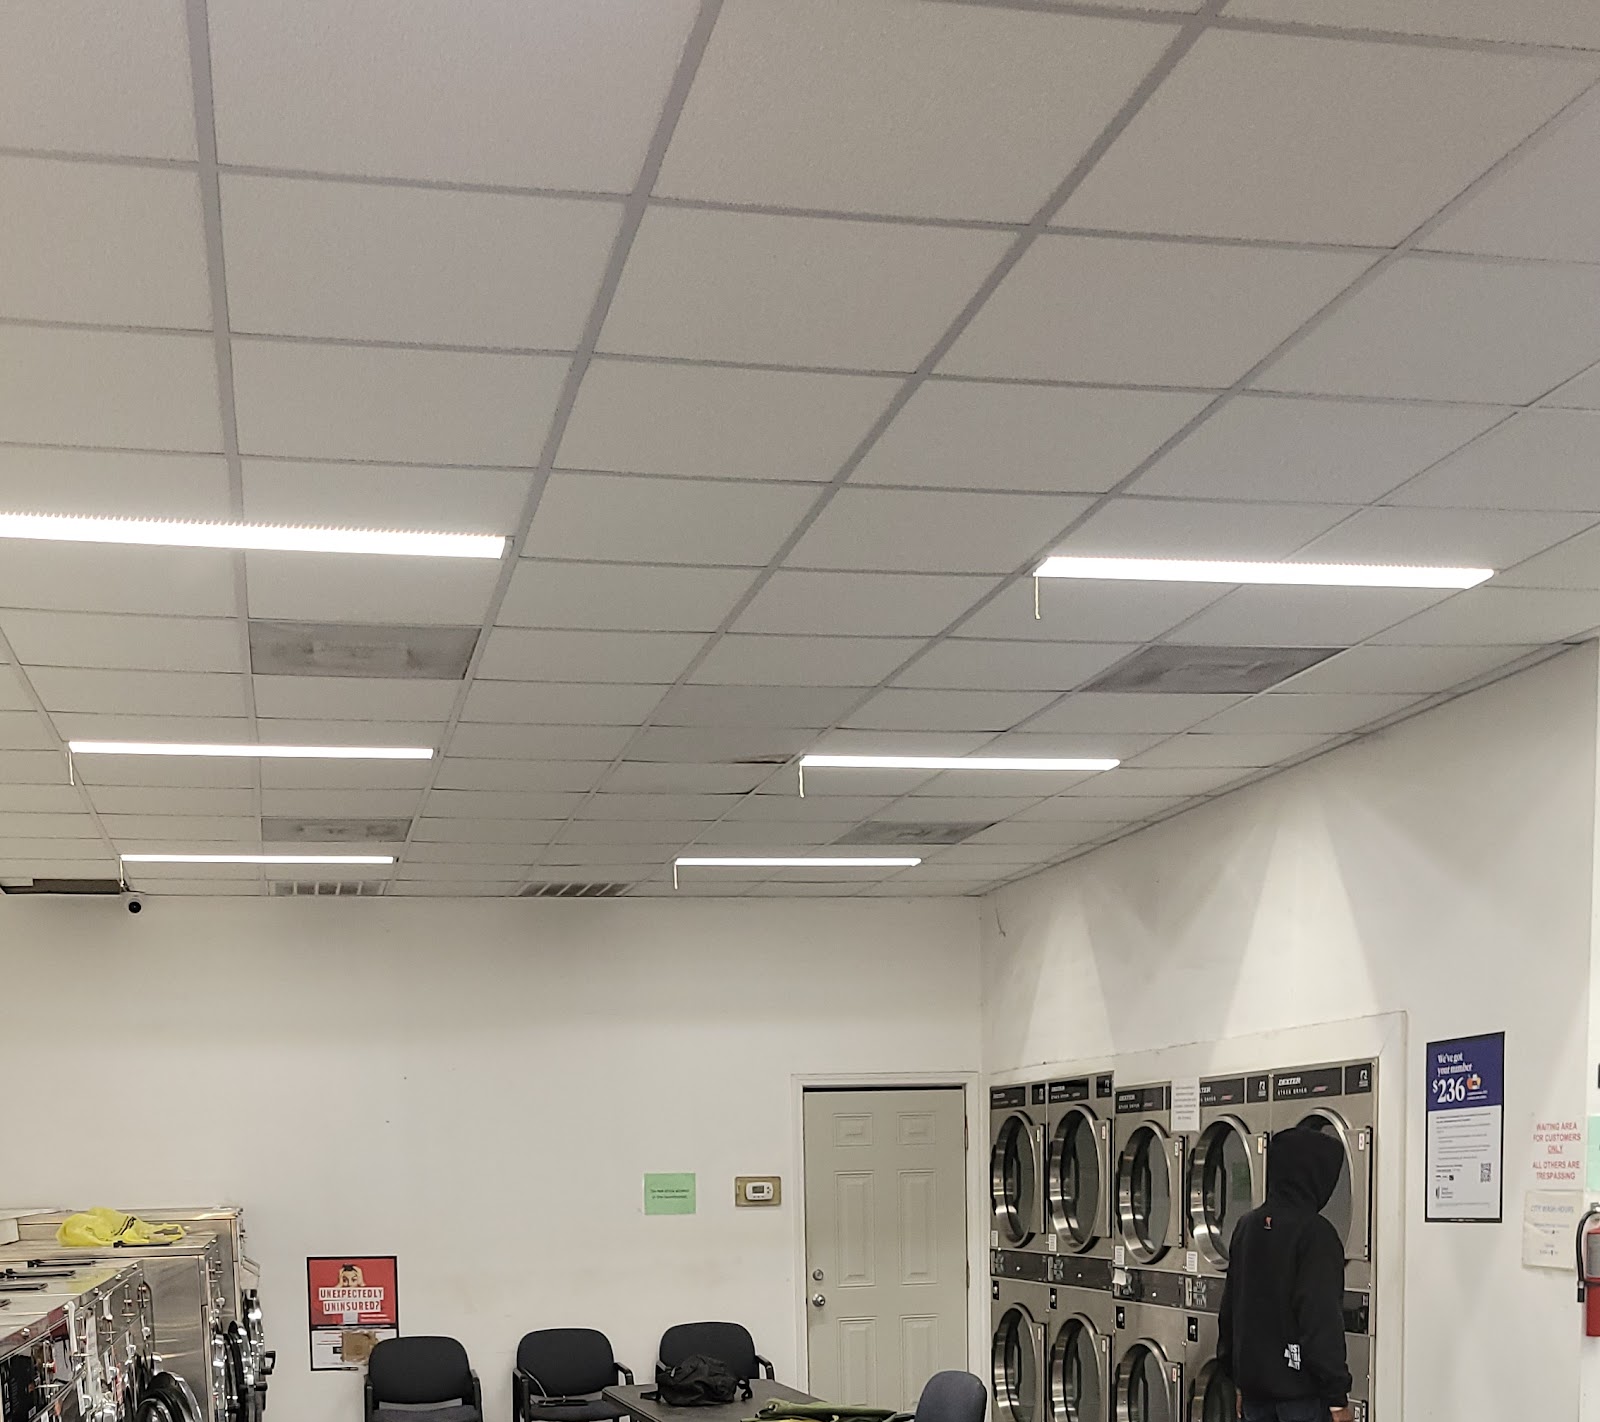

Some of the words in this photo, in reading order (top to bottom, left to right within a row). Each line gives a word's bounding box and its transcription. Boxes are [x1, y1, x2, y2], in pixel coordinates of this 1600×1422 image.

[1453, 1052, 1463, 1064] got
[1437, 1066, 1450, 1078] your
[1450, 1061, 1473, 1074] number
[1278, 1077, 1302, 1086] DEXTER
[1432, 1076, 1466, 1103] $236
[1536, 1123, 1560, 1131] WAITING
[1561, 1122, 1577, 1130] AREA
[1533, 1134, 1544, 1142] FOR
[1544, 1133, 1581, 1142] CUSTOMERS
[1548, 1145, 1563, 1154] ONLY
[1532, 1161, 1543, 1169] ALL
[1543, 1161, 1567, 1169] OTHERS
[1567, 1161, 1580, 1169] ARE
[1536, 1172, 1576, 1180] TRESPASSING
[320, 1289, 382, 1298] UNEXPECTEDLY
[324, 1301, 380, 1312] UNINSURED?
